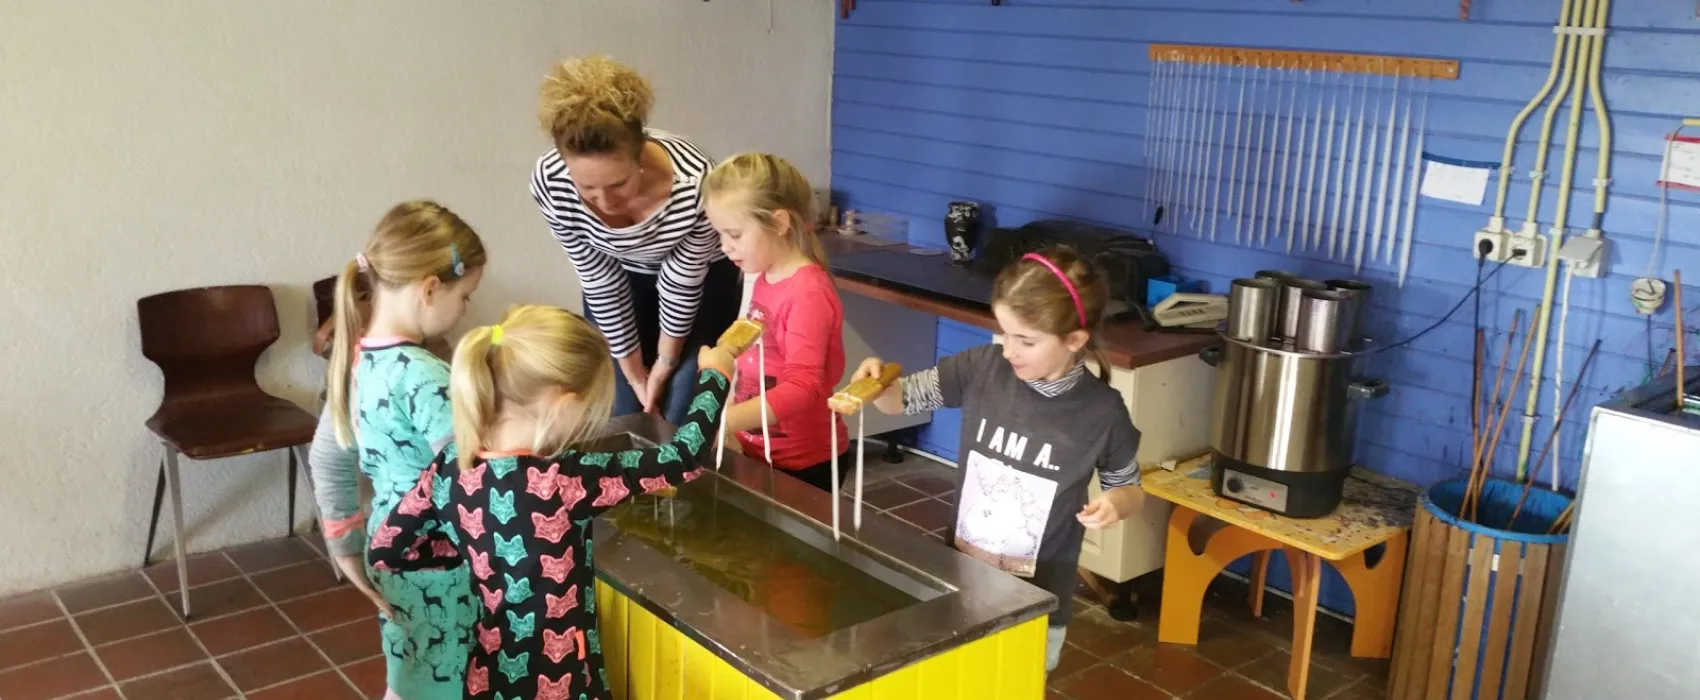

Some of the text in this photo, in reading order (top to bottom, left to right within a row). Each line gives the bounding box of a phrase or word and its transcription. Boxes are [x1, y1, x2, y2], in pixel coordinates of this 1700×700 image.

[976, 418, 1060, 471] I AM A..
